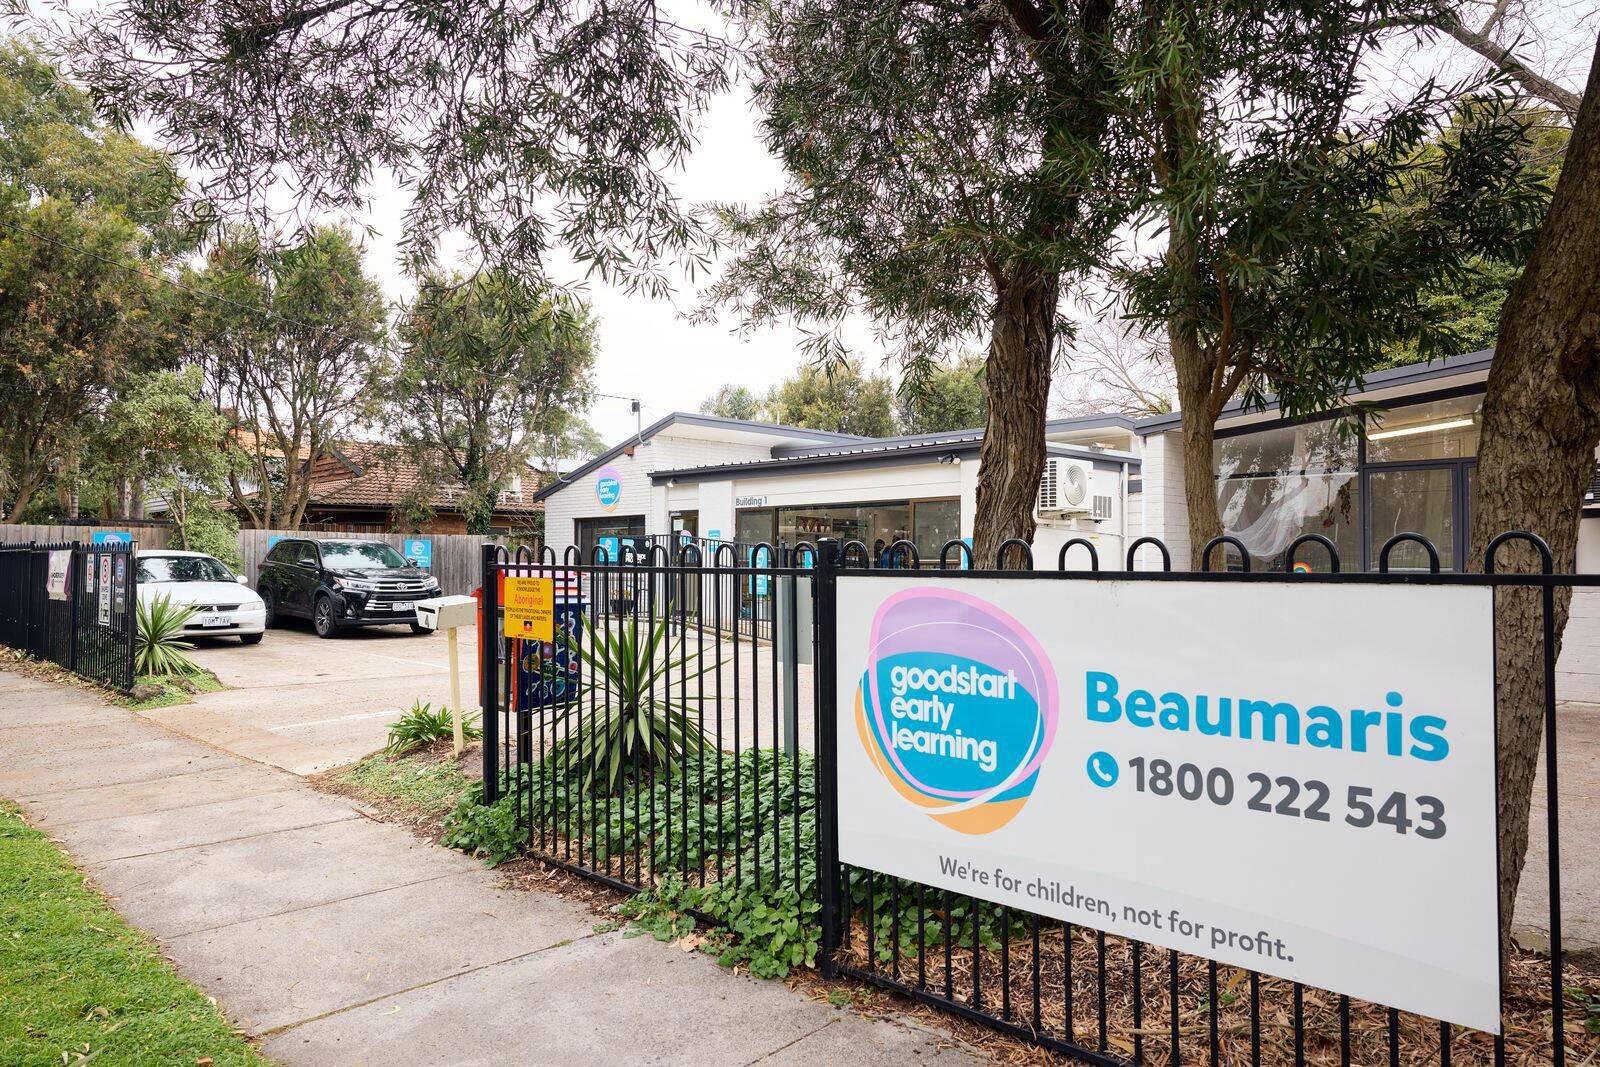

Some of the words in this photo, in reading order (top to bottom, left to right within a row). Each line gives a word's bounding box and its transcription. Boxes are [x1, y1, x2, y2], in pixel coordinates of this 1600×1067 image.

[736, 497, 763, 507] Building
[514, 593, 544, 607] Aboriginal
[890, 664, 1018, 700] goodstart
[890, 694, 955, 731] early
[1085, 670, 1450, 763] Beaumaris
[891, 720, 998, 773] learning
[1128, 756, 1235, 806] 1800
[1246, 772, 1331, 823] 222
[1344, 785, 1447, 840] 543
[939, 855, 990, 886] We're
[993, 867, 1022, 893] for
[1026, 877, 1118, 924] children,
[1123, 905, 1163, 930] not
[1167, 909, 1205, 939] for
[1210, 926, 1295, 963] profit.
